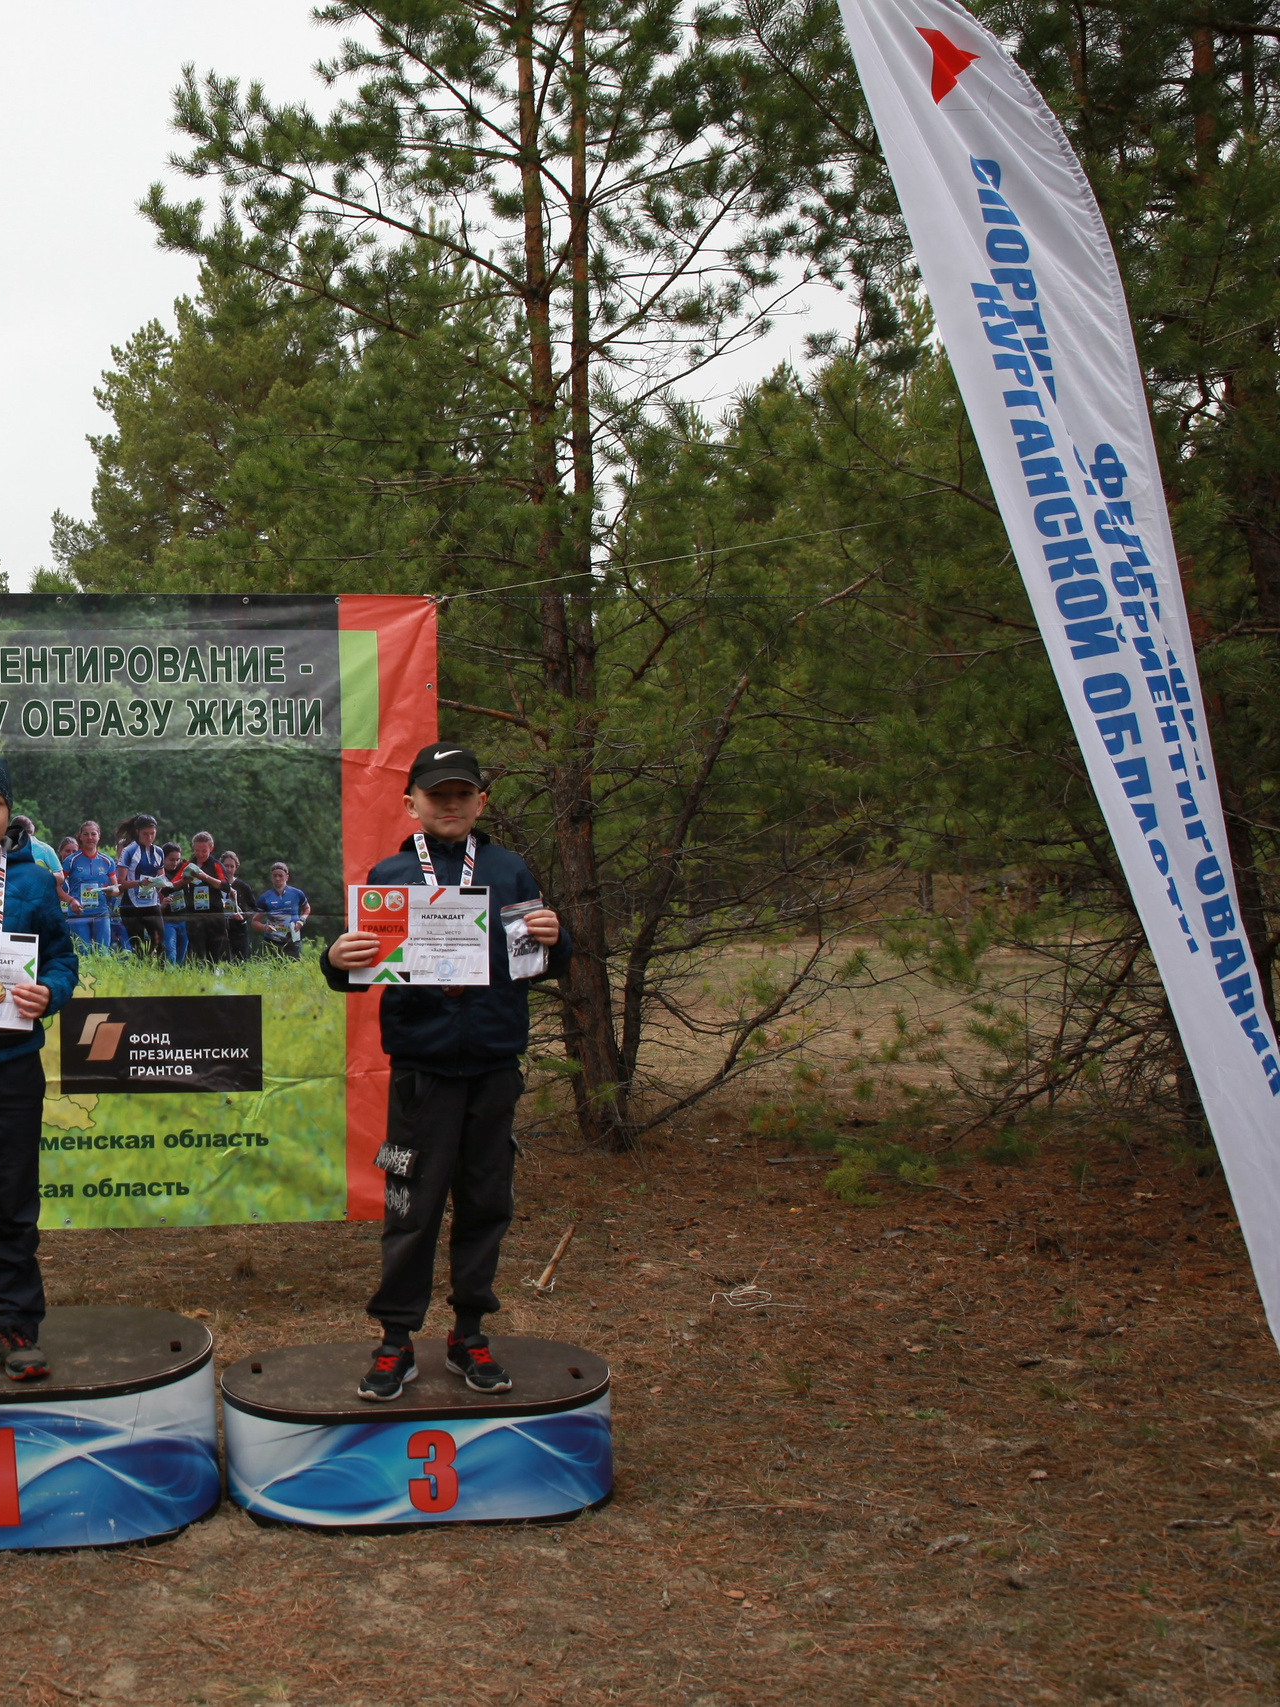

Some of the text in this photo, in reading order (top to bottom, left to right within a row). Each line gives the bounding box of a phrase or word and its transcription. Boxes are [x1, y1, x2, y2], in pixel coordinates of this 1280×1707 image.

[971, 282, 1127, 661] КУРГАНСКОЙ
[21, 699, 174, 738] ОБРАЗУ
[185, 698, 323, 737] ЖИЗНИ
[362, 924, 406, 933] ГРАМОТА
[128, 1032, 171, 1047] ФОНД
[128, 1047, 250, 1062] ПРЕЗИДЕНТСКИХ
[128, 1064, 194, 1077] ГРАНТОВ
[39, 1128, 270, 1151] менская область
[90, 1176, 191, 1198] область
[408, 1430, 458, 1514] 3
